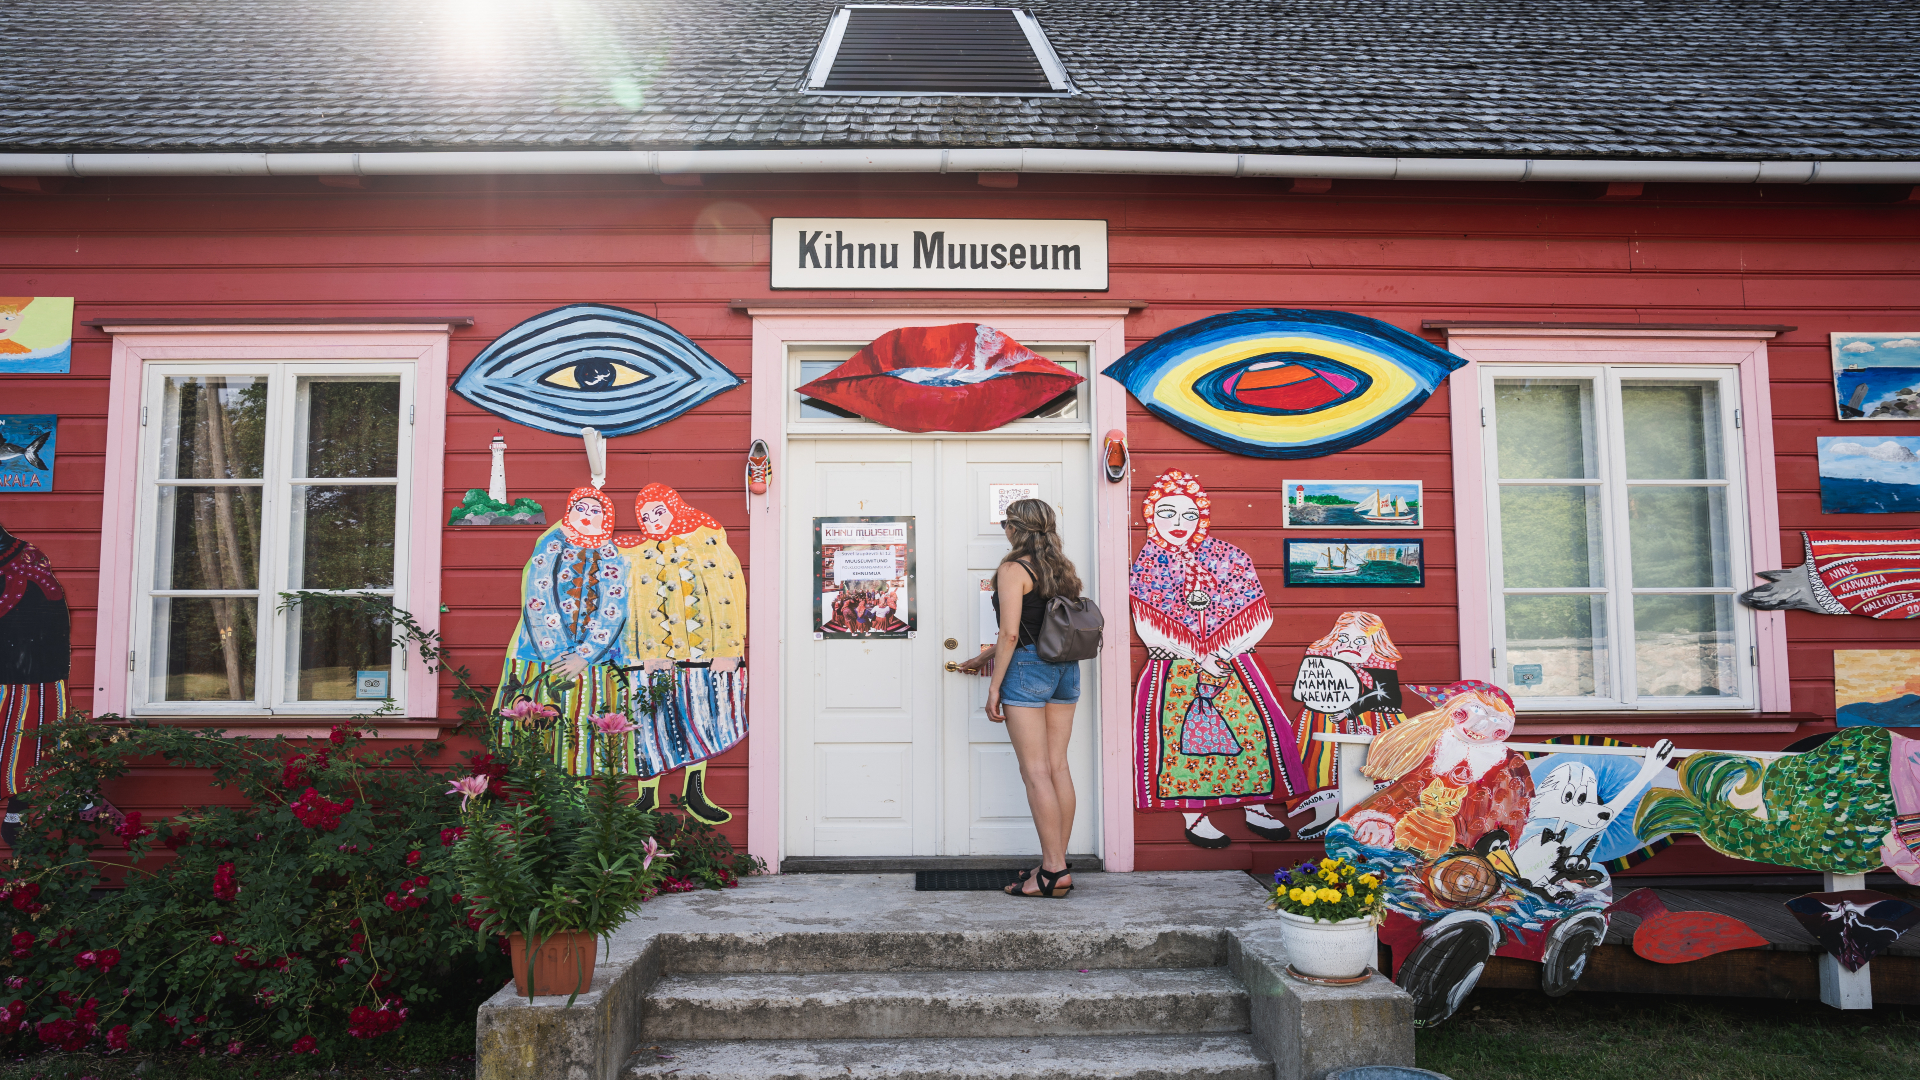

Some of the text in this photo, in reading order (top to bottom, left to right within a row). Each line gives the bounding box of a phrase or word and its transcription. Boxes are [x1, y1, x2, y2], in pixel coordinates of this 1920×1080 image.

[798, 230, 1082, 270] Kihnu Muuseum
[0, 473, 42, 488] KALA
[1828, 564, 1858, 581] NING
[1840, 574, 1887, 592] KARVAKALA
[1862, 593, 1914, 613] HALLHÜLJES
[1906, 604, 1920, 614] 20
[1301, 668, 1334, 679] TAHA
[1298, 678, 1354, 691] MAMMAL
[1300, 690, 1351, 703] KAEVATA
[1325, 792, 1336, 800] JA
